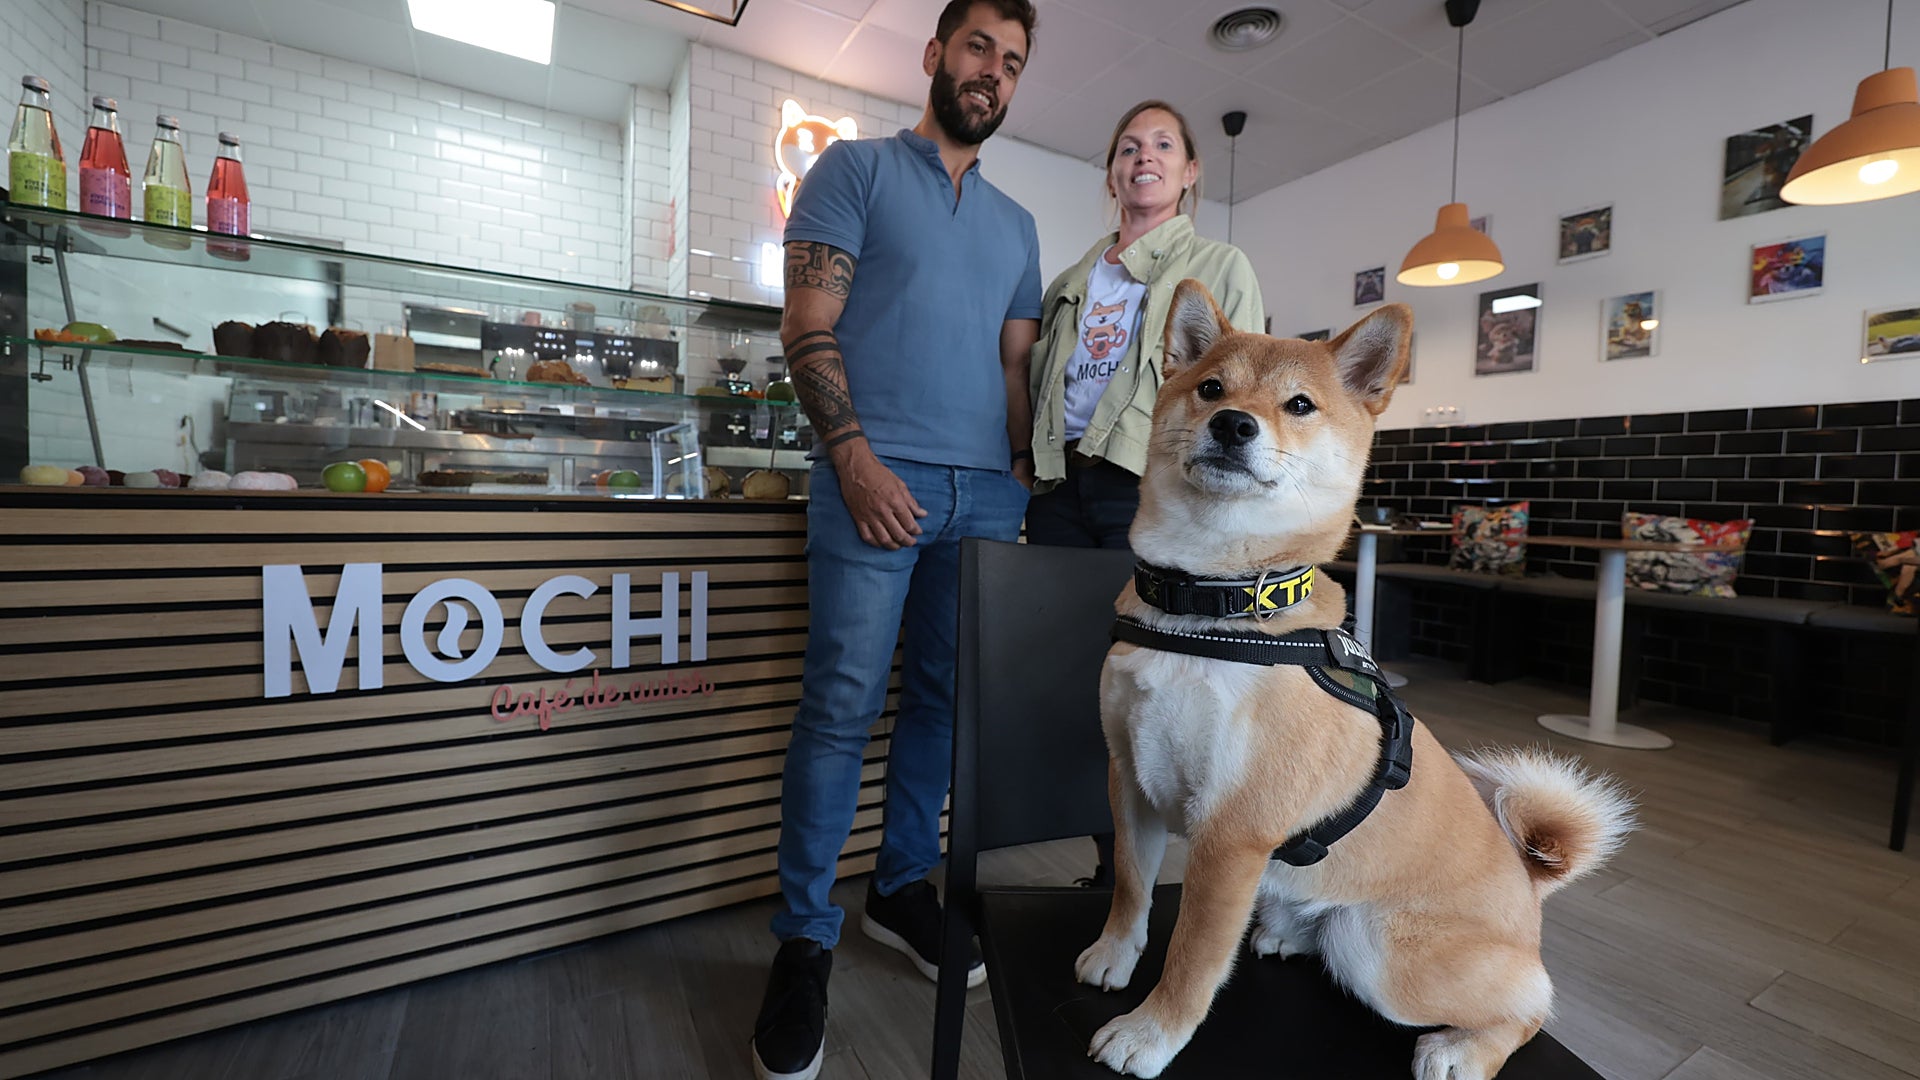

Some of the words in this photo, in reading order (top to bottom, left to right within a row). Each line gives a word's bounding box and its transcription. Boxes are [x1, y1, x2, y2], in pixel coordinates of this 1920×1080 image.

[1077, 361, 1119, 381] MOCH
[262, 562, 708, 698] MOCHI
[491, 678, 575, 731] Café
[583, 668, 624, 711] de
[628, 669, 715, 704] autor
